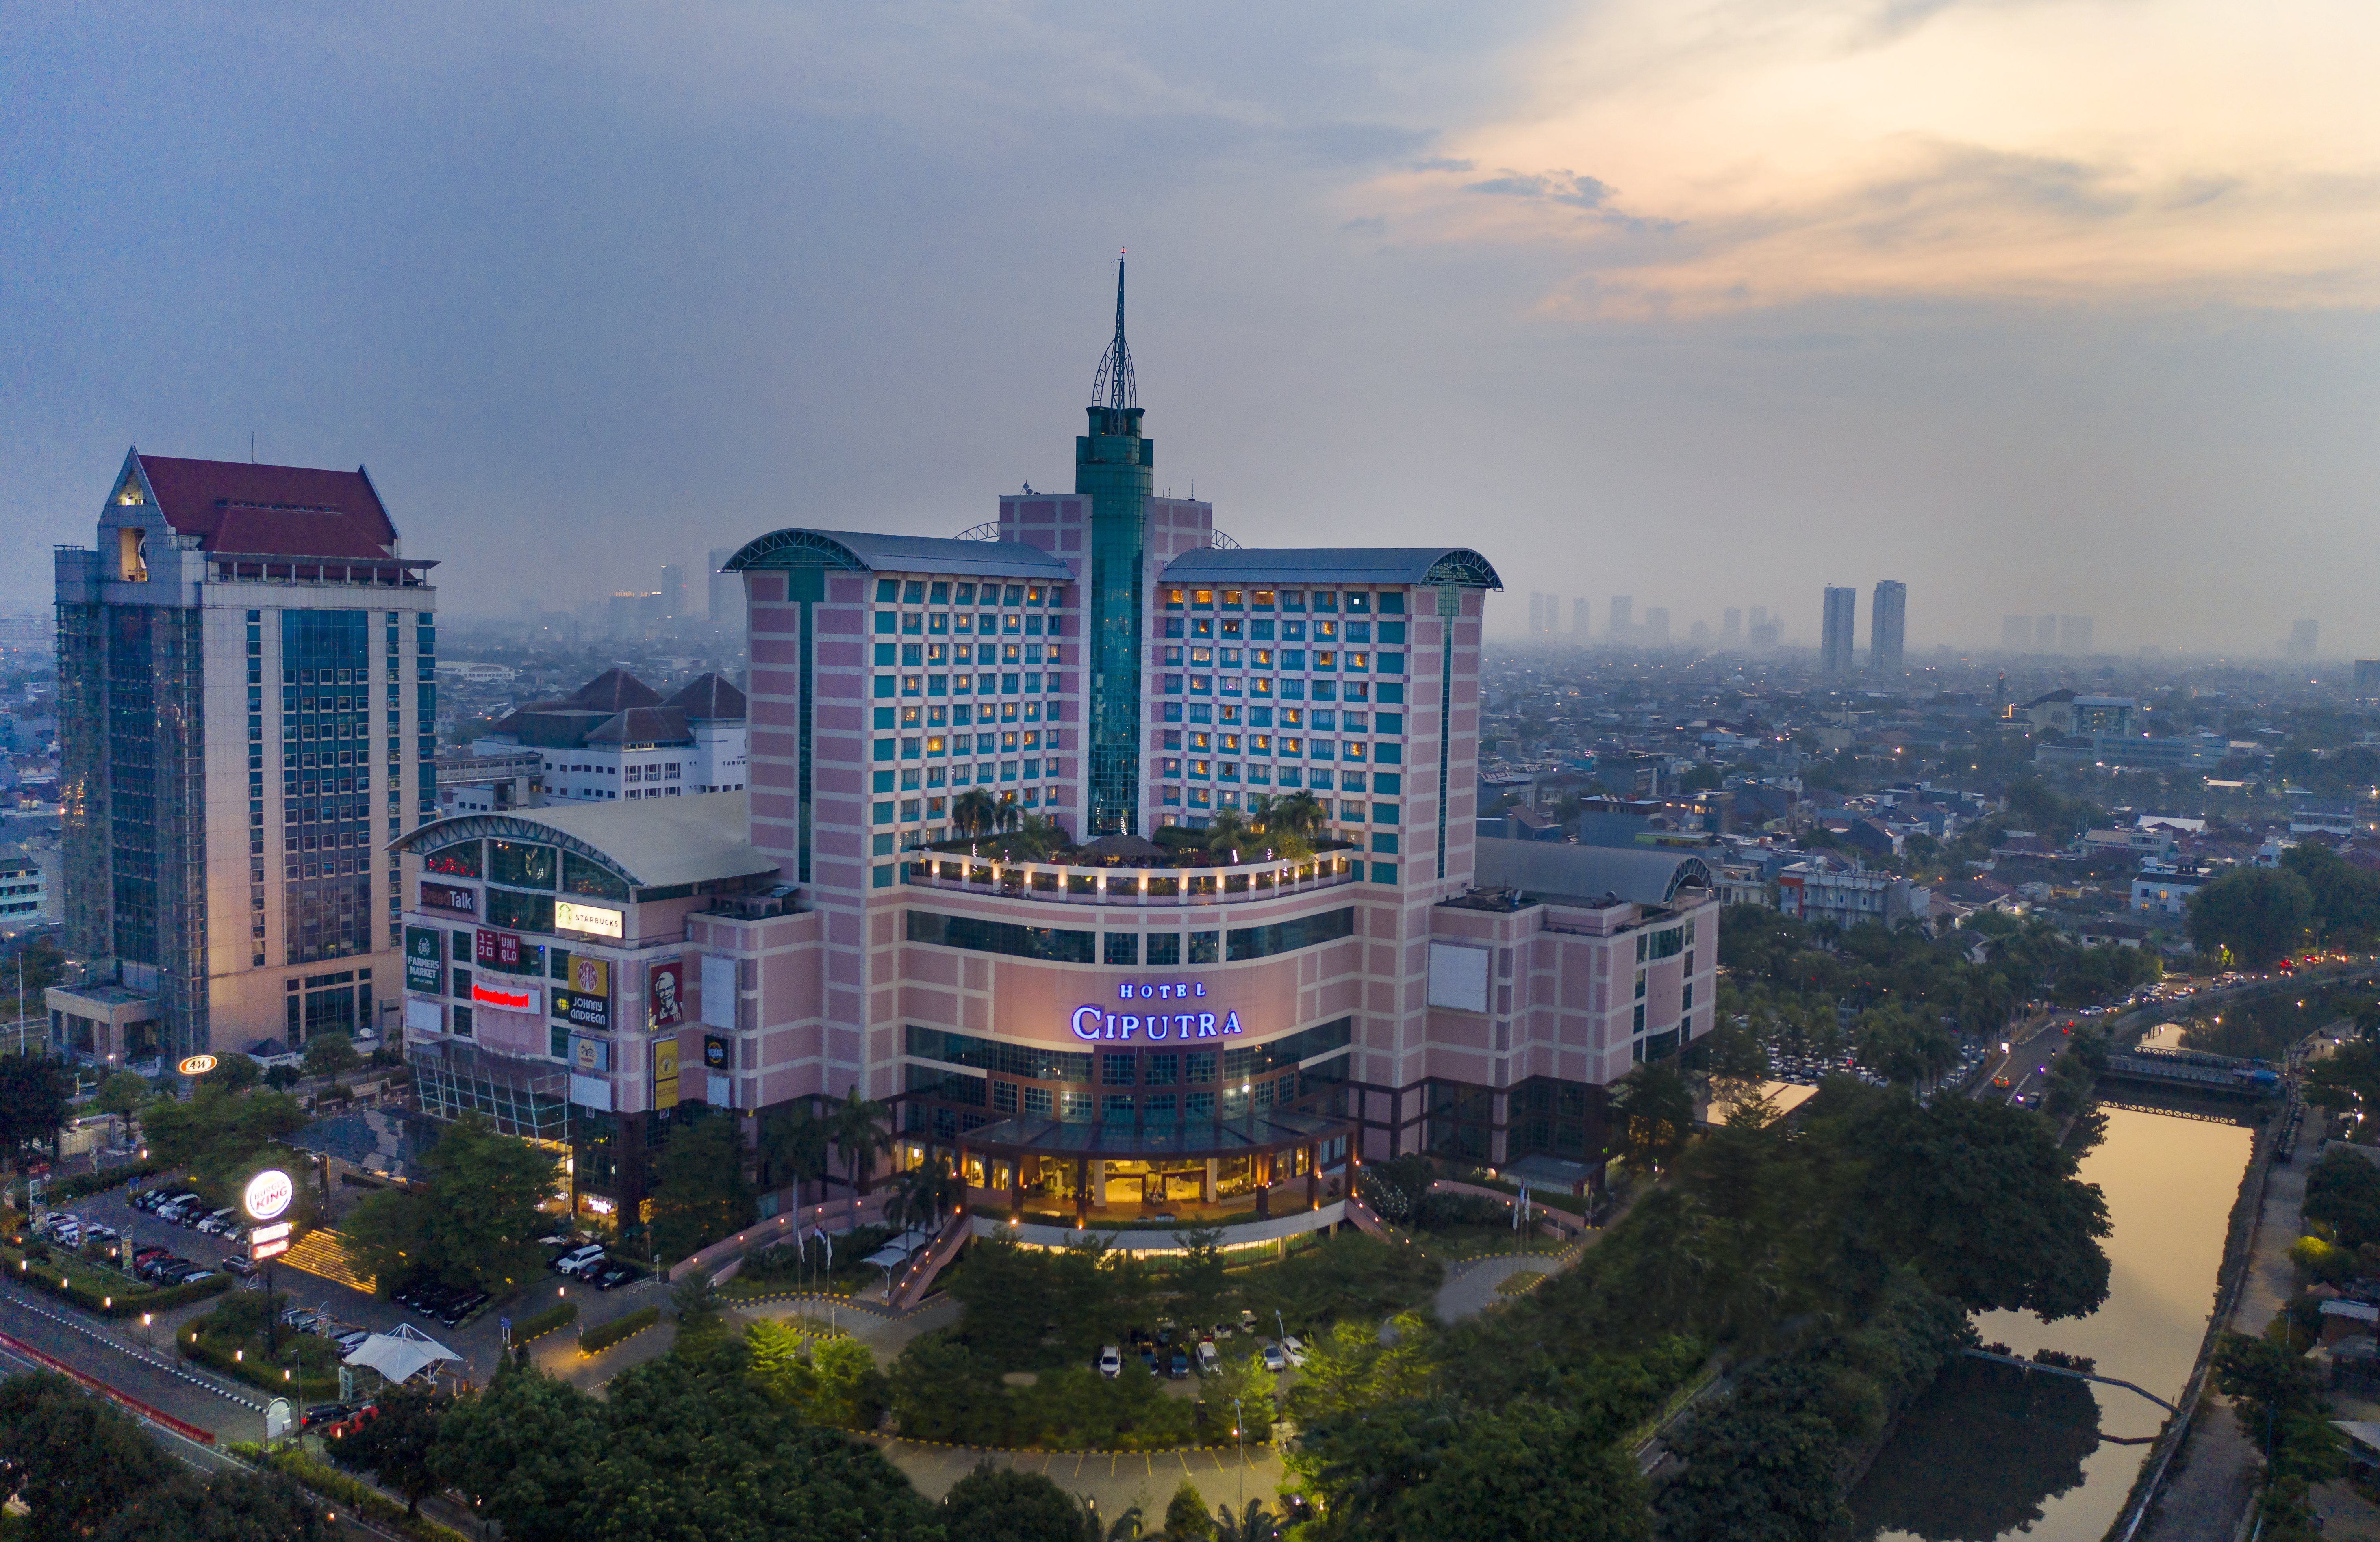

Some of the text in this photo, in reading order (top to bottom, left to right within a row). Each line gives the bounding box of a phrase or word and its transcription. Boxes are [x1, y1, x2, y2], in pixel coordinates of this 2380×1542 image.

[576, 914, 618, 927] STARBUCKS
[408, 956, 439, 969] FARMERS
[410, 965, 437, 978] MARKET
[1119, 982, 1206, 999] HOTEL
[1072, 1006, 1242, 1040] CIPUTRA
[254, 1179, 286, 1200] BURGER
[256, 1186, 287, 1210] KING
